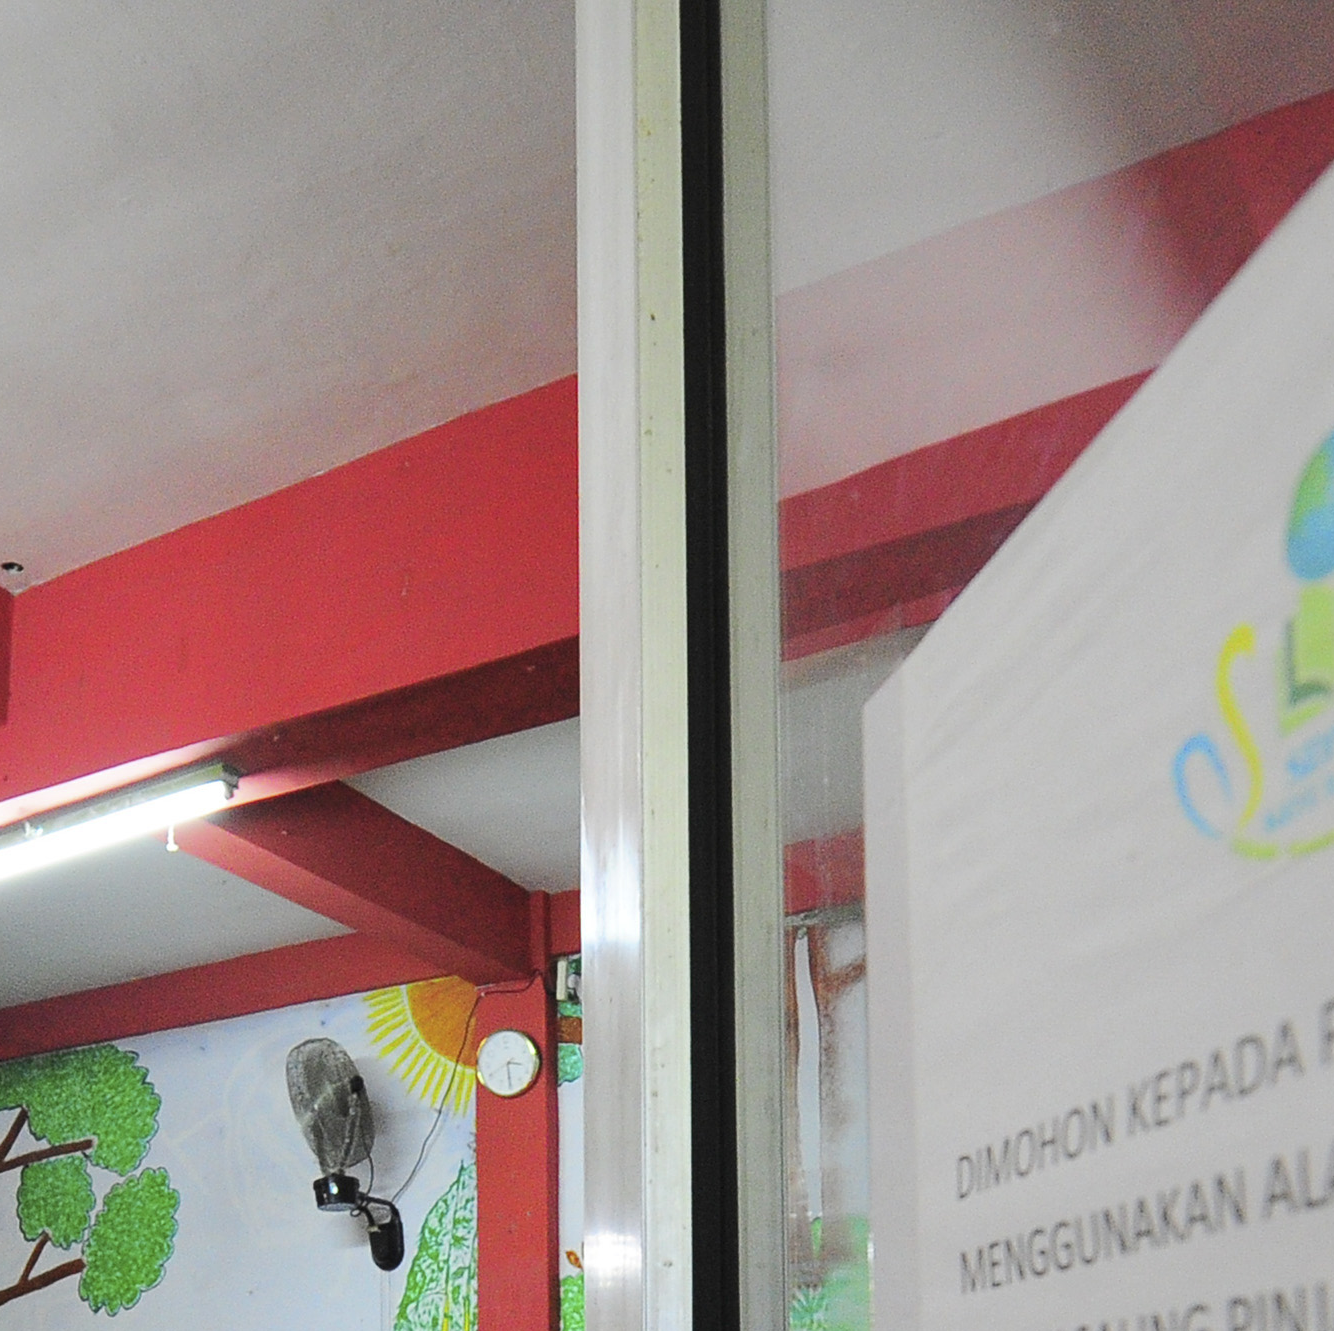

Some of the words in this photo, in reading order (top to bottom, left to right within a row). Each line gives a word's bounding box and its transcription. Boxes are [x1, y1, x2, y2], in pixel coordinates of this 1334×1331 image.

[956, 1096, 1116, 1201] DIMOHON
[1125, 1021, 1304, 1136] KEPADA
[960, 1170, 1248, 1296] MENGGUNAKAN
